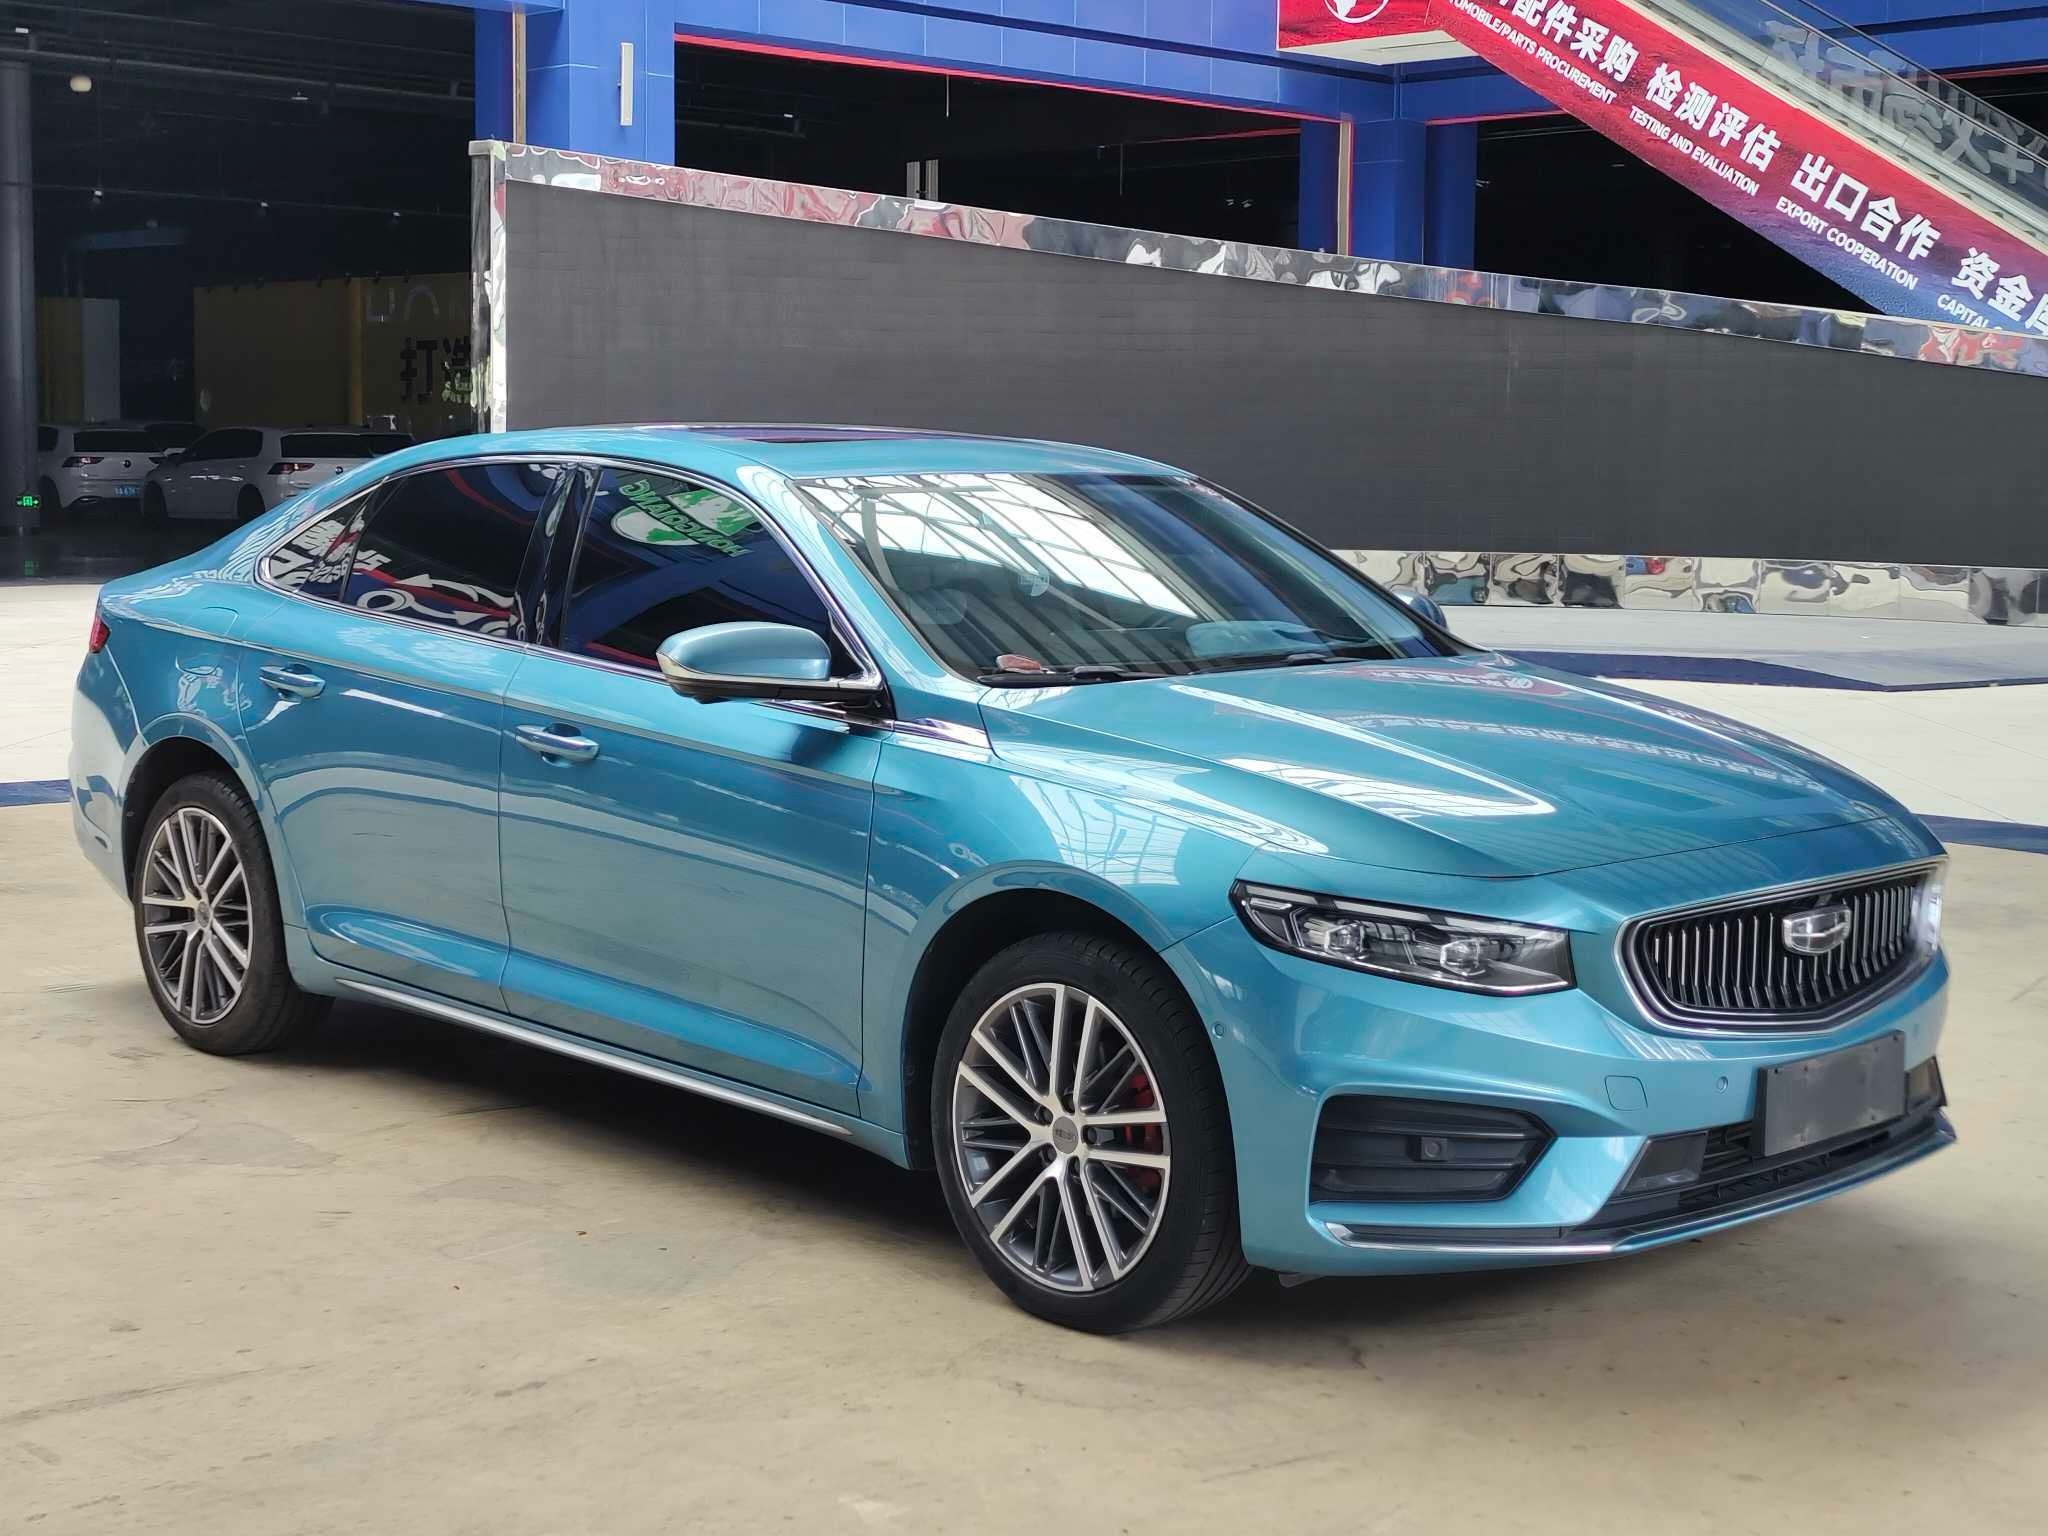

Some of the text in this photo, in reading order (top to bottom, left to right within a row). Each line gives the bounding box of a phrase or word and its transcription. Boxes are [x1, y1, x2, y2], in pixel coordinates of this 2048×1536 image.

[1498, 0, 1640, 83] 配件采购
[1536, 47, 1618, 105] PROCUREMENT
[1629, 105, 1760, 197] TESTING AND EVALUATION
[1646, 63, 1782, 173] 检测评估
[1776, 196, 1919, 290] EXPORT COOPERATION
[1790, 153, 1942, 261] 出口合作
